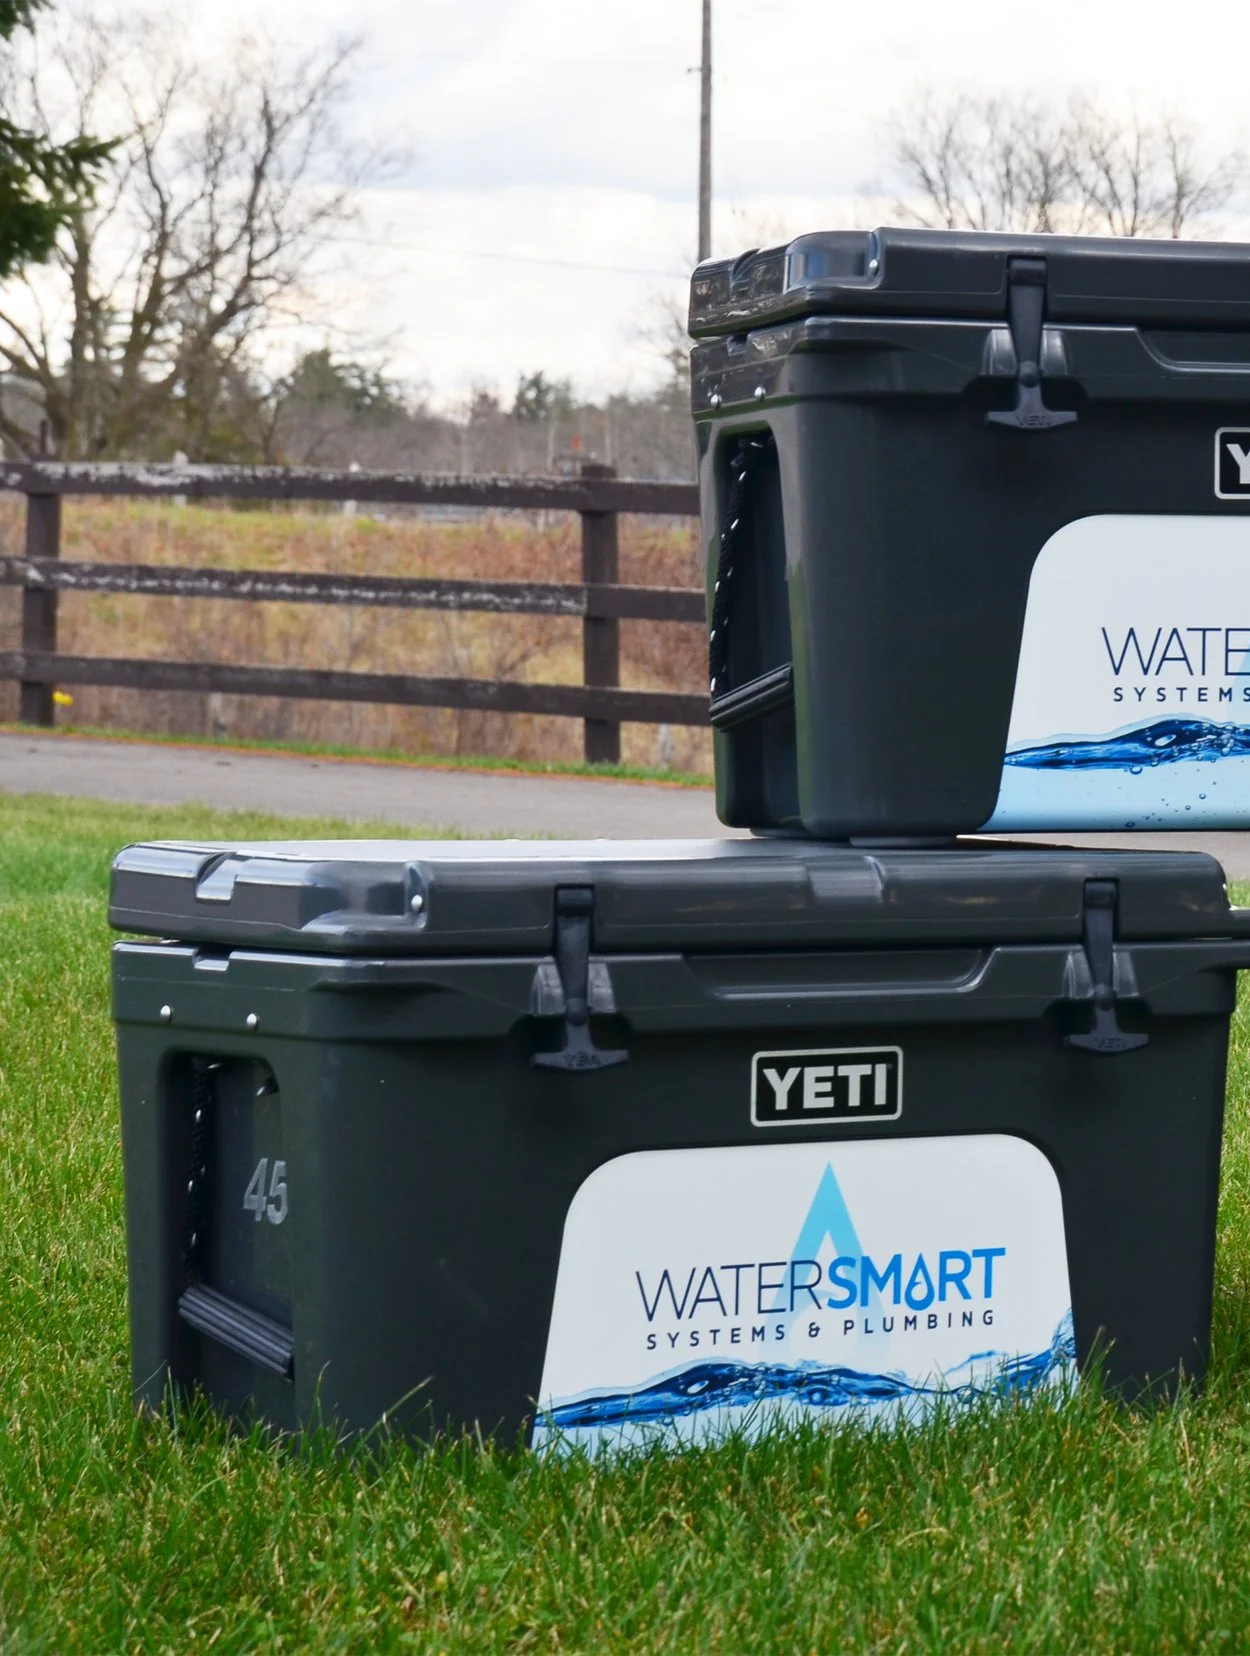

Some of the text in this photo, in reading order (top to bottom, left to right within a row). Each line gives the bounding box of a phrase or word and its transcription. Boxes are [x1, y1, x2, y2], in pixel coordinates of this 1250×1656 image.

[762, 1063, 887, 1111] YETI
[243, 1157, 289, 1225] 45
[646, 1309, 994, 1351] SYSTEMS & PLUMBING
